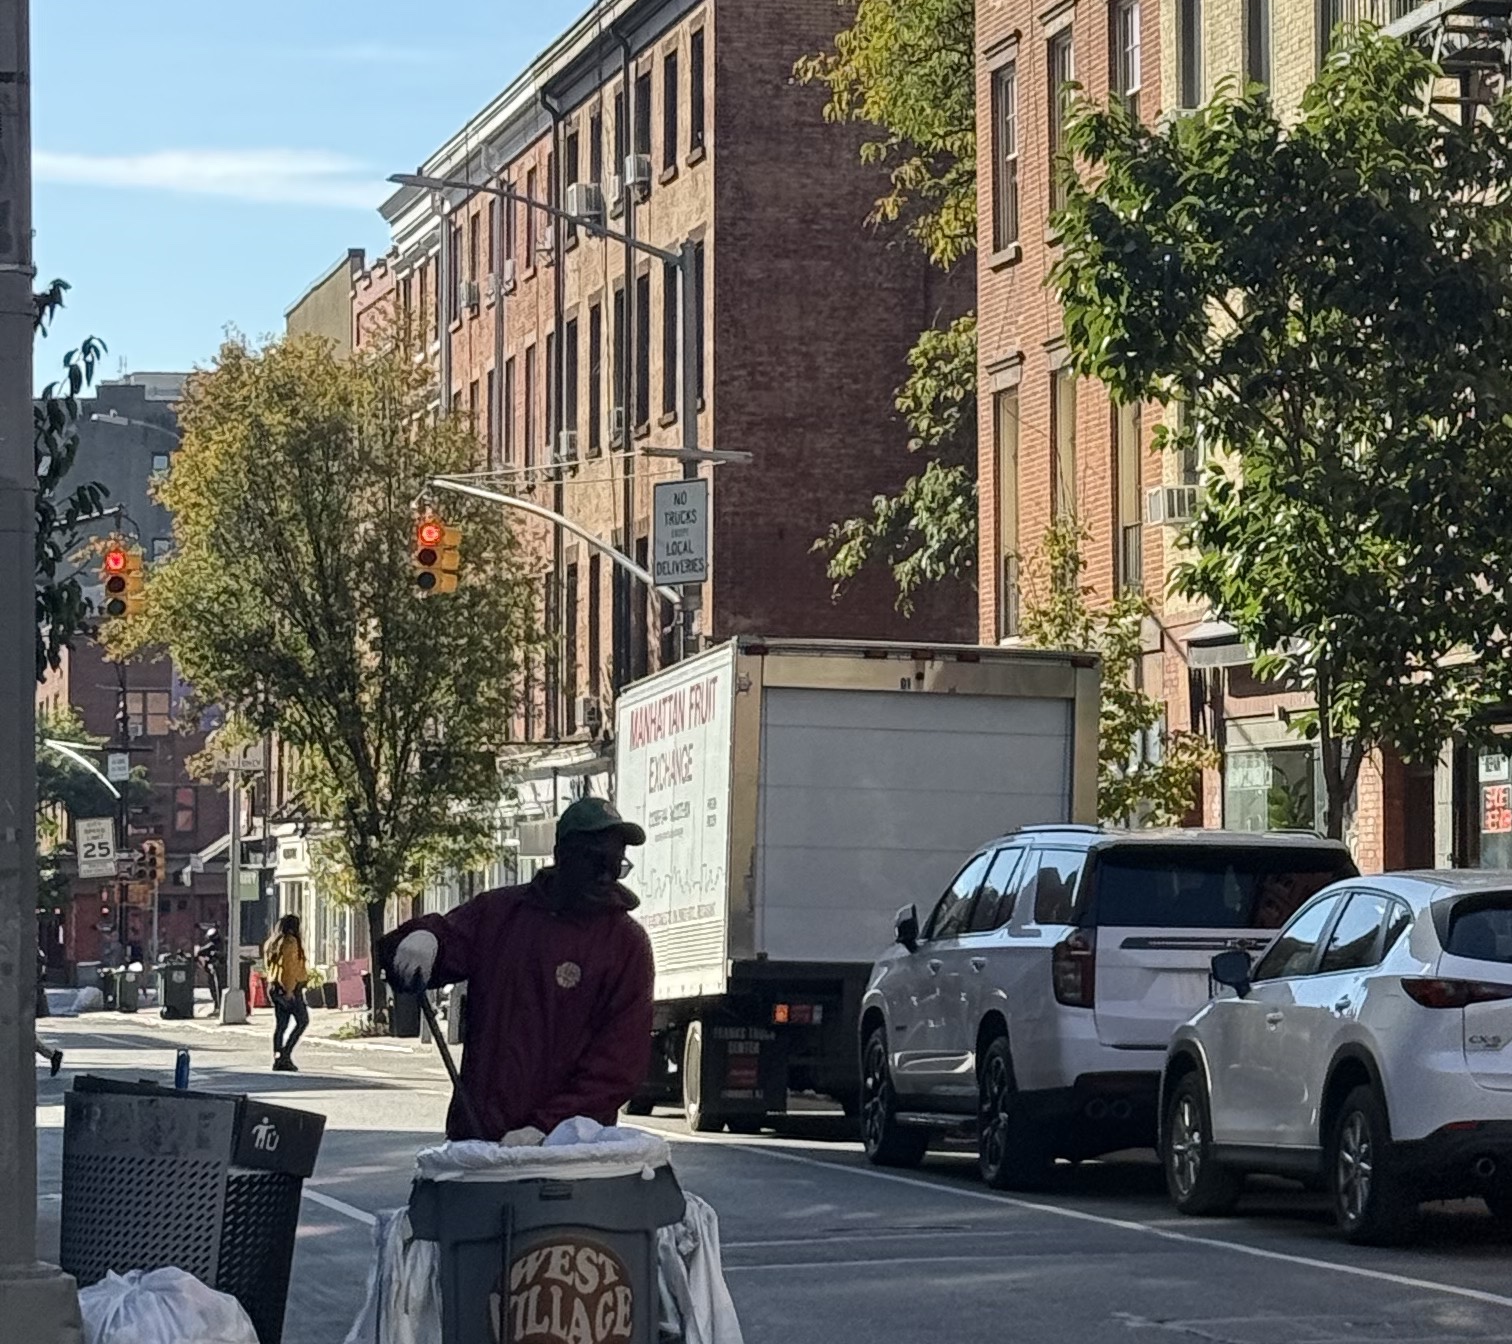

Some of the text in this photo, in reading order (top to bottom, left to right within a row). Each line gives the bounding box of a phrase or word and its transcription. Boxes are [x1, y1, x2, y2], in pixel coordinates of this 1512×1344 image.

[673, 490, 688, 506] NO
[664, 509, 698, 526] TRUCKS
[666, 539, 694, 556] LOCAL
[657, 558, 705, 576] DELIVERIES
[629, 675, 719, 752] MANHATTAN FRUIT
[649, 743, 694, 794] EXCHANGE
[83, 841, 111, 859] 25
[509, 1244, 620, 1295] WEST
